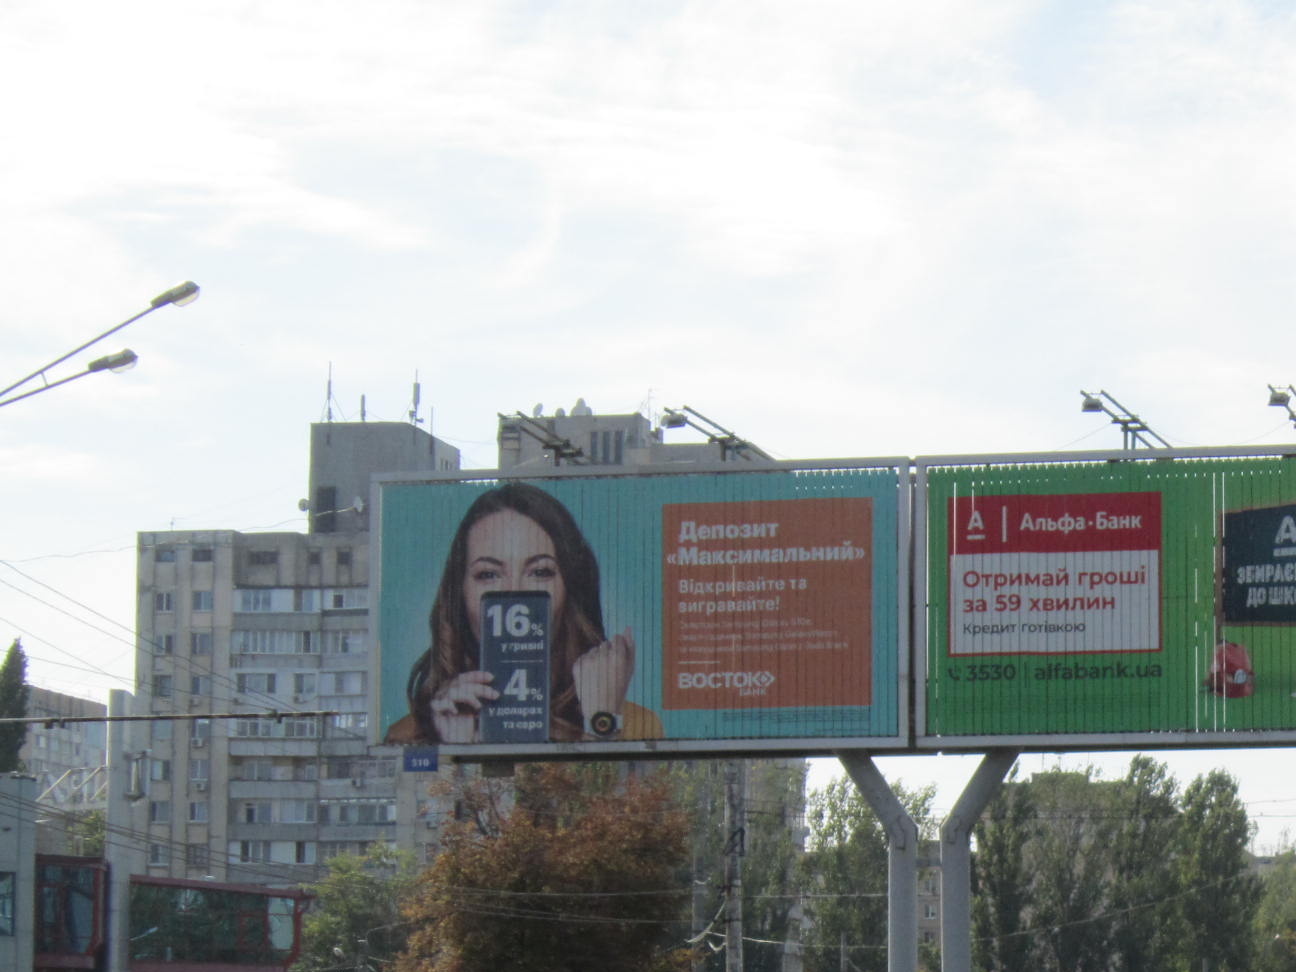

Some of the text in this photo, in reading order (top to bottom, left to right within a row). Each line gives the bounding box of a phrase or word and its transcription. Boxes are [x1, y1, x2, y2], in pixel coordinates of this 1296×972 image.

[678, 521, 779, 543] Депозит
[667, 540, 864, 566] «Максимальний»
[679, 577, 807, 595] Відкривайте та
[963, 565, 1146, 591] Отримай гроші
[678, 597, 780, 616] вигравайте!
[963, 594, 1115, 613] за 59 хвилин
[963, 620, 1086, 637] Кредит готівкою
[966, 661, 1163, 681] 3530 alfabank.ua
